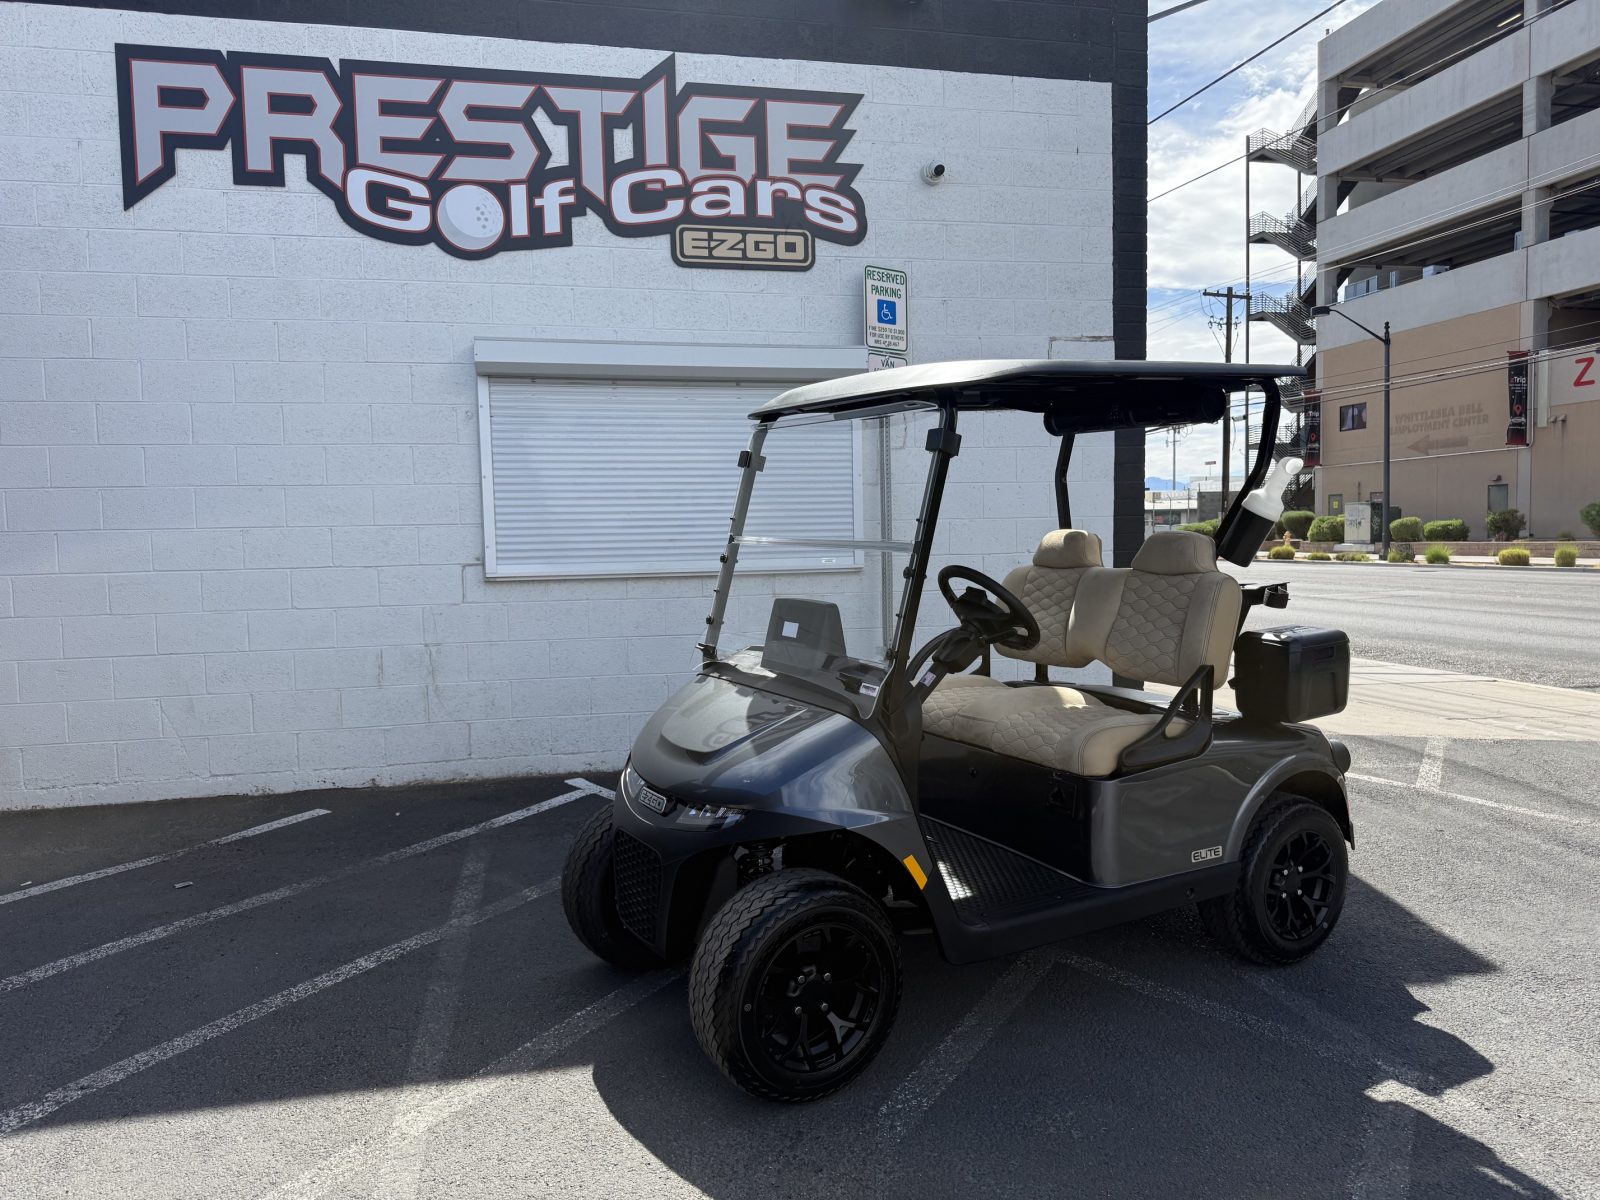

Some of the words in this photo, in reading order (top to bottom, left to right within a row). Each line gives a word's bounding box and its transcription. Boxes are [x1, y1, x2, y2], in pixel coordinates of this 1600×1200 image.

[127, 57, 848, 206] PRESTIGE
[345, 167, 577, 251] Golf
[610, 167, 859, 234] Cars
[682, 230, 806, 262] EZGO
[866, 269, 905, 286] RESERVED
[871, 284, 902, 299] PARKING
[881, 359, 895, 368] VAN
[1452, 414, 1489, 427] CENTER
[640, 789, 664, 811] EZGO
[1193, 847, 1221, 861] ELITE
